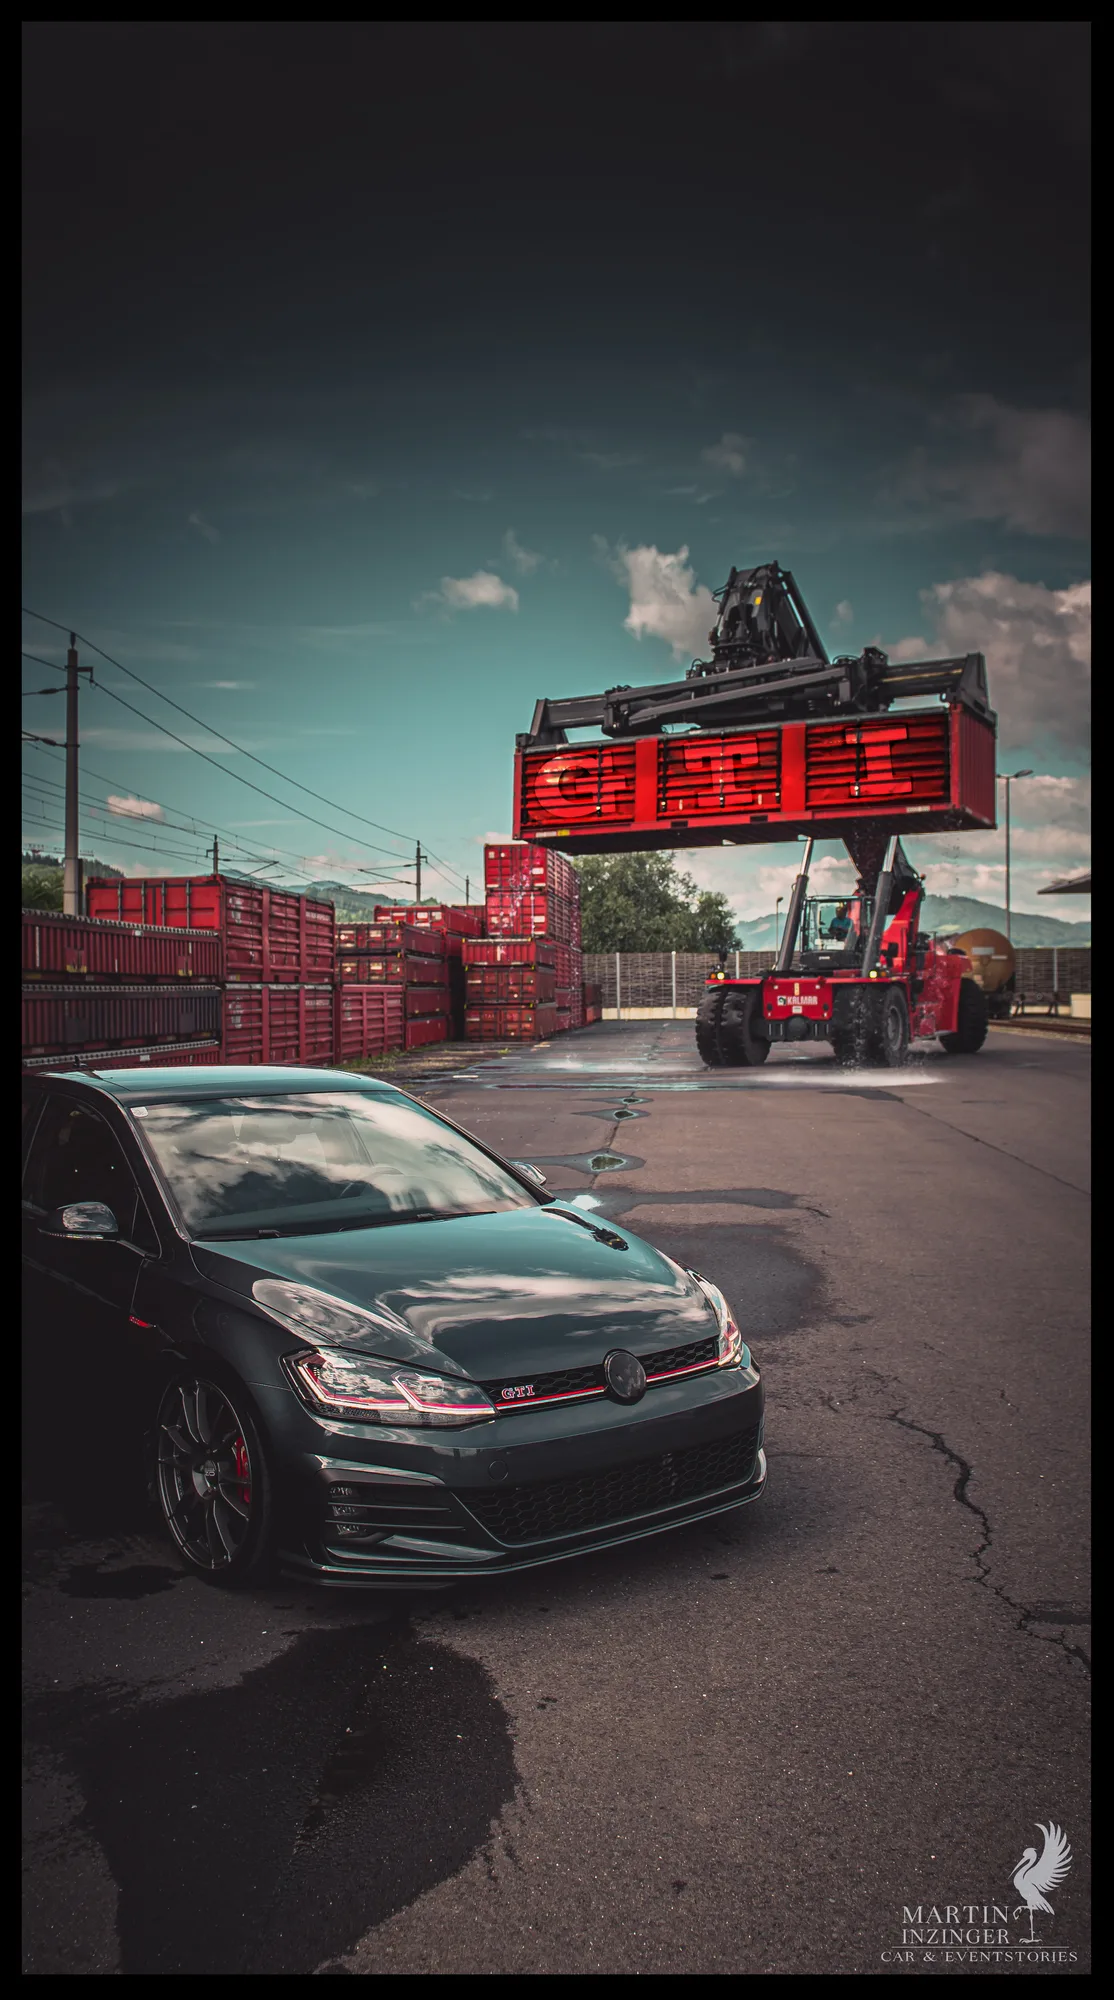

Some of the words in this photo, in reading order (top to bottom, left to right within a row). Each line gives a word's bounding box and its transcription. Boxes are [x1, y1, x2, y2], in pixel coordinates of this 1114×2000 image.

[534, 726, 912, 818] GTI
[787, 995, 818, 1005] KALMAR
[501, 1385, 535, 1399] GTI
